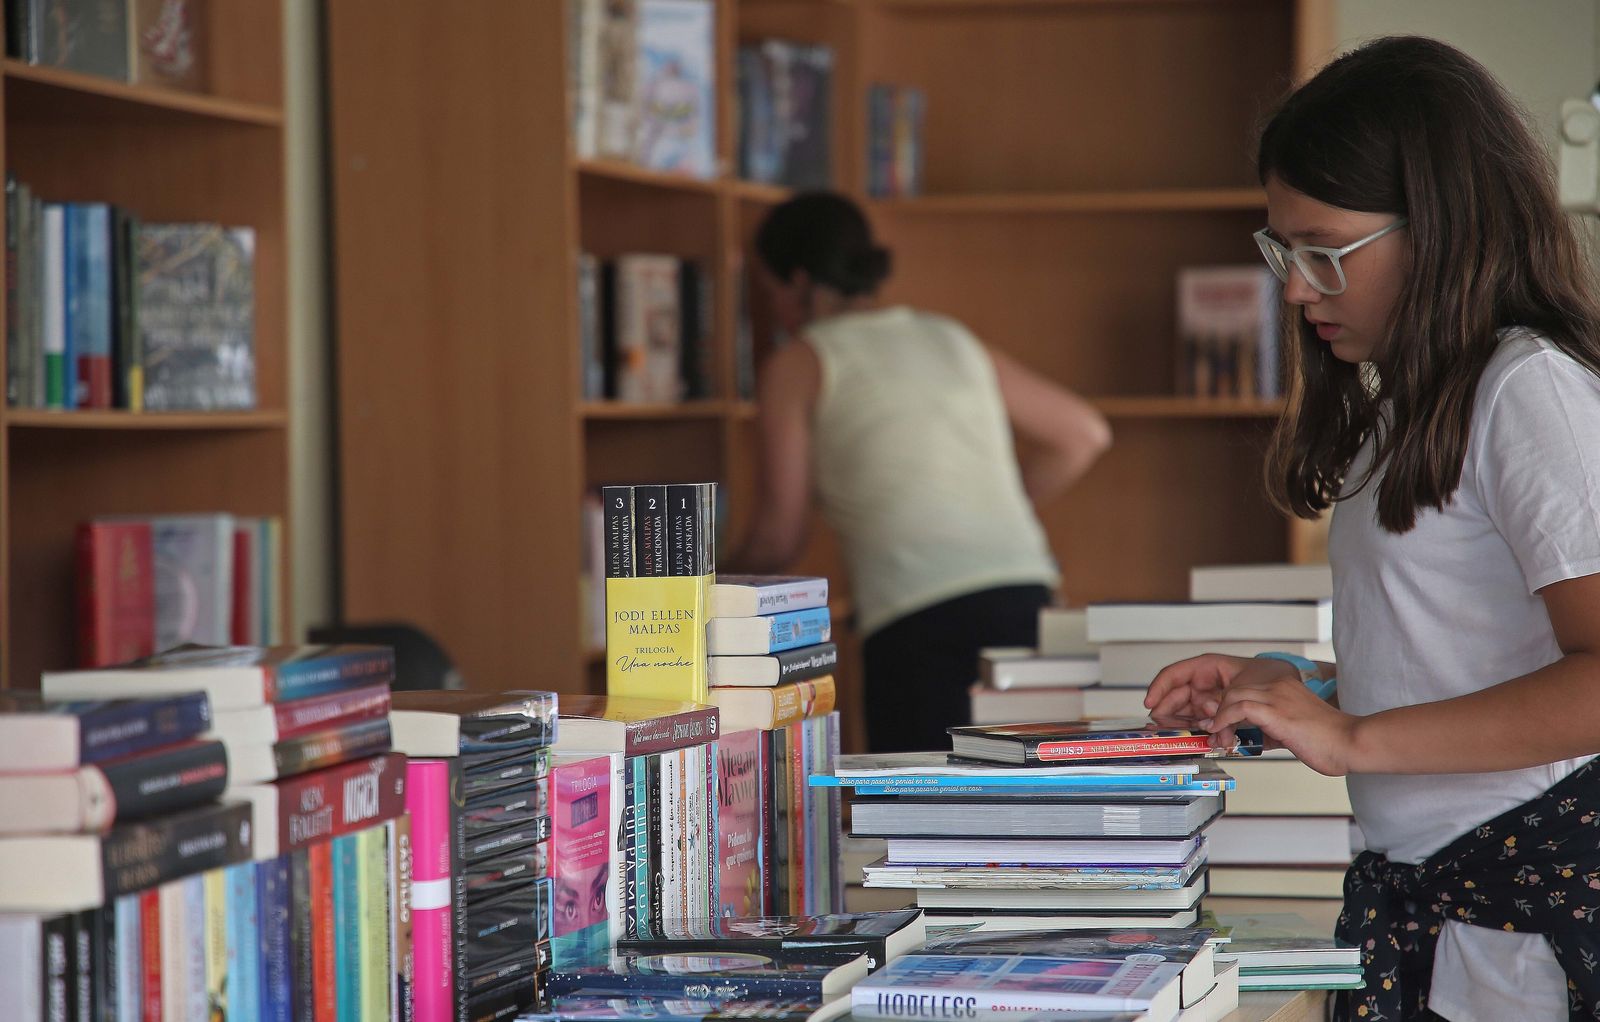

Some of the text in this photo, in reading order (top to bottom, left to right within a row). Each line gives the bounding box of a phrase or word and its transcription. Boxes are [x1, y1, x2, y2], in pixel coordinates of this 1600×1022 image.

[615, 498, 624, 508] 3
[648, 498, 656, 510] 2
[681, 498, 686, 509] 1
[614, 610, 694, 623] JODI ELLEN
[629, 624, 681, 635] MALPAS
[616, 656, 694, 672] Una noche
[895, 778, 914, 786] genial
[625, 805, 635, 871] CULPA
[636, 802, 647, 870] CULPA
